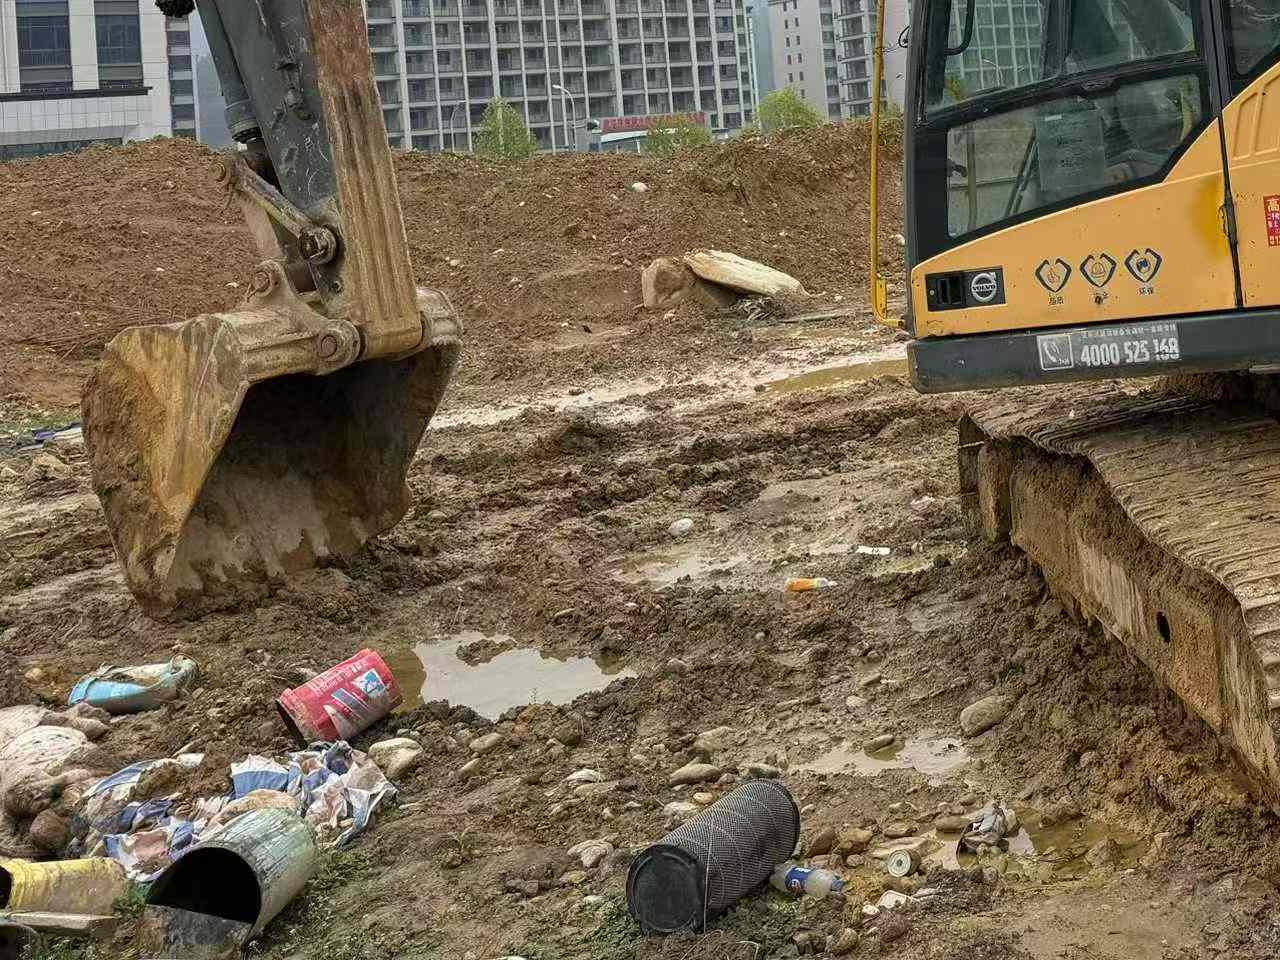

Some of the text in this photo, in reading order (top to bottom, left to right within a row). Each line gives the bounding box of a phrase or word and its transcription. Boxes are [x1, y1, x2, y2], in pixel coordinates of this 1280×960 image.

[971, 283, 996, 292] VOLVO
[1080, 338, 1180, 367] 4000 525 168
